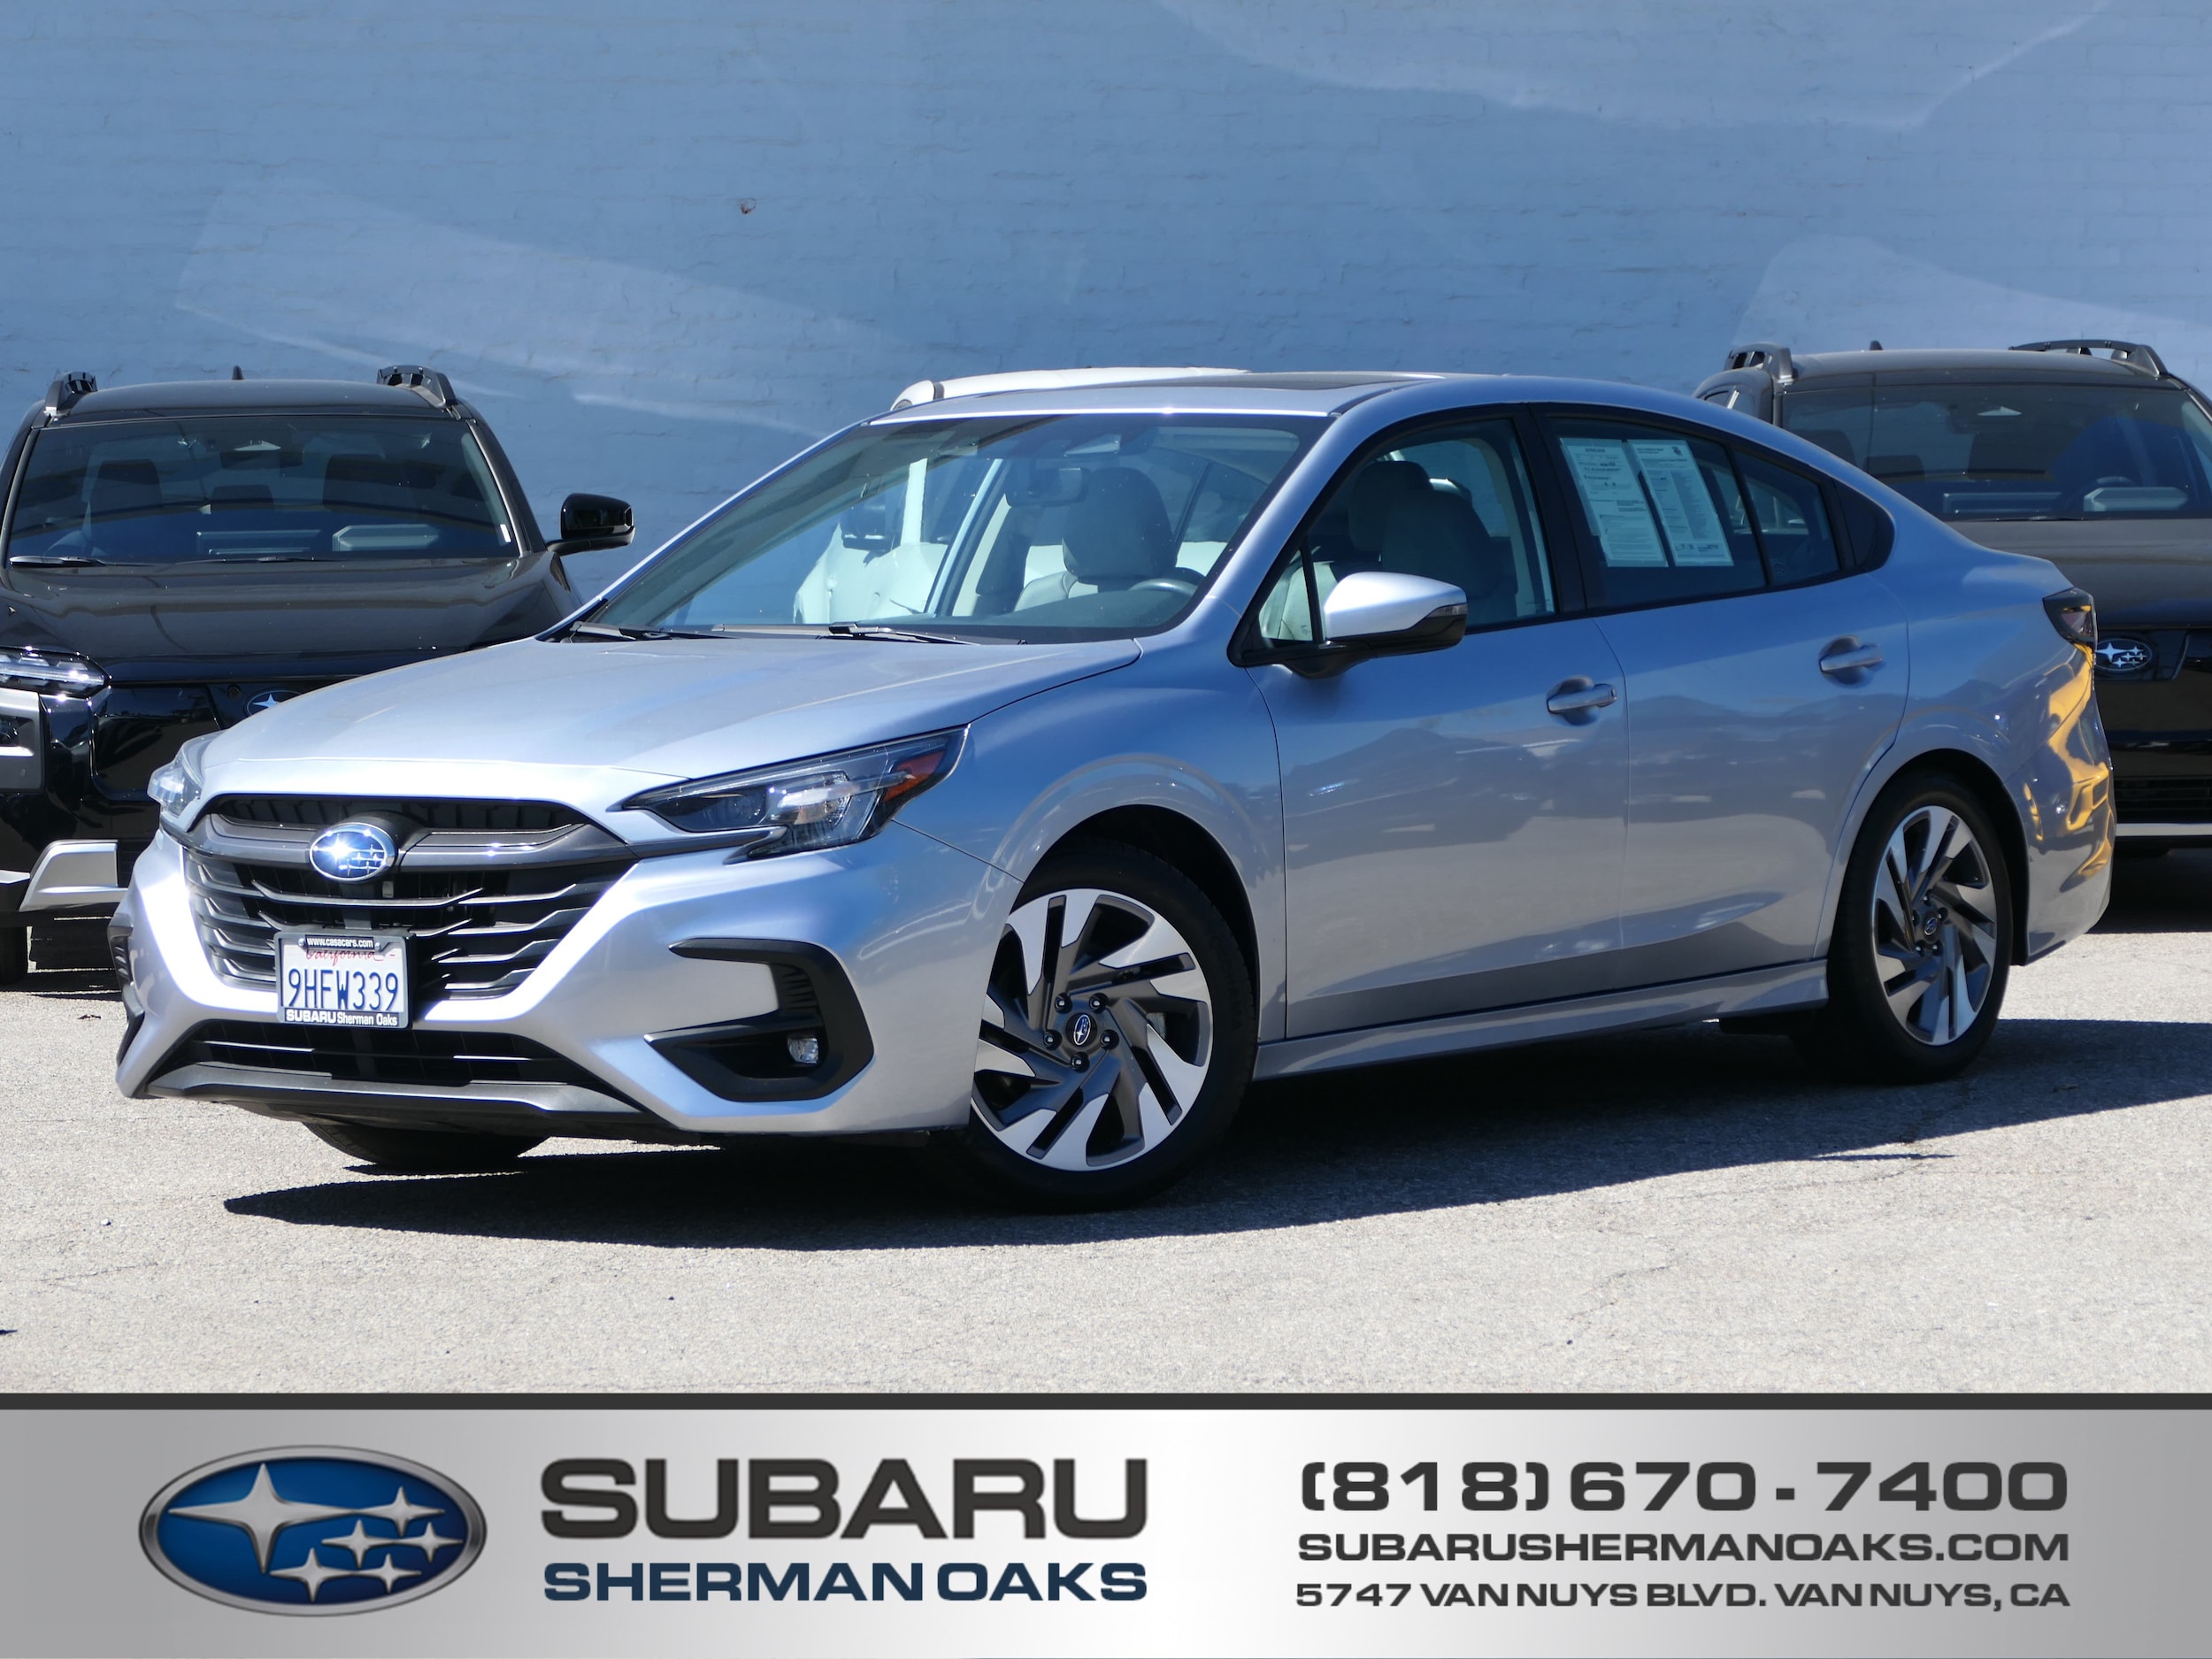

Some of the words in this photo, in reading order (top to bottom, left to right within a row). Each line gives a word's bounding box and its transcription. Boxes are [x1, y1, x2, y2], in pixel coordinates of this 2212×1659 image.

[307, 936, 373, 949] www.casacars.com
[288, 968, 398, 1011] 9HFW339
[286, 1009, 338, 1024] SUBARU
[337, 1011, 374, 1025] Sherman
[376, 1013, 398, 1026] Oaks
